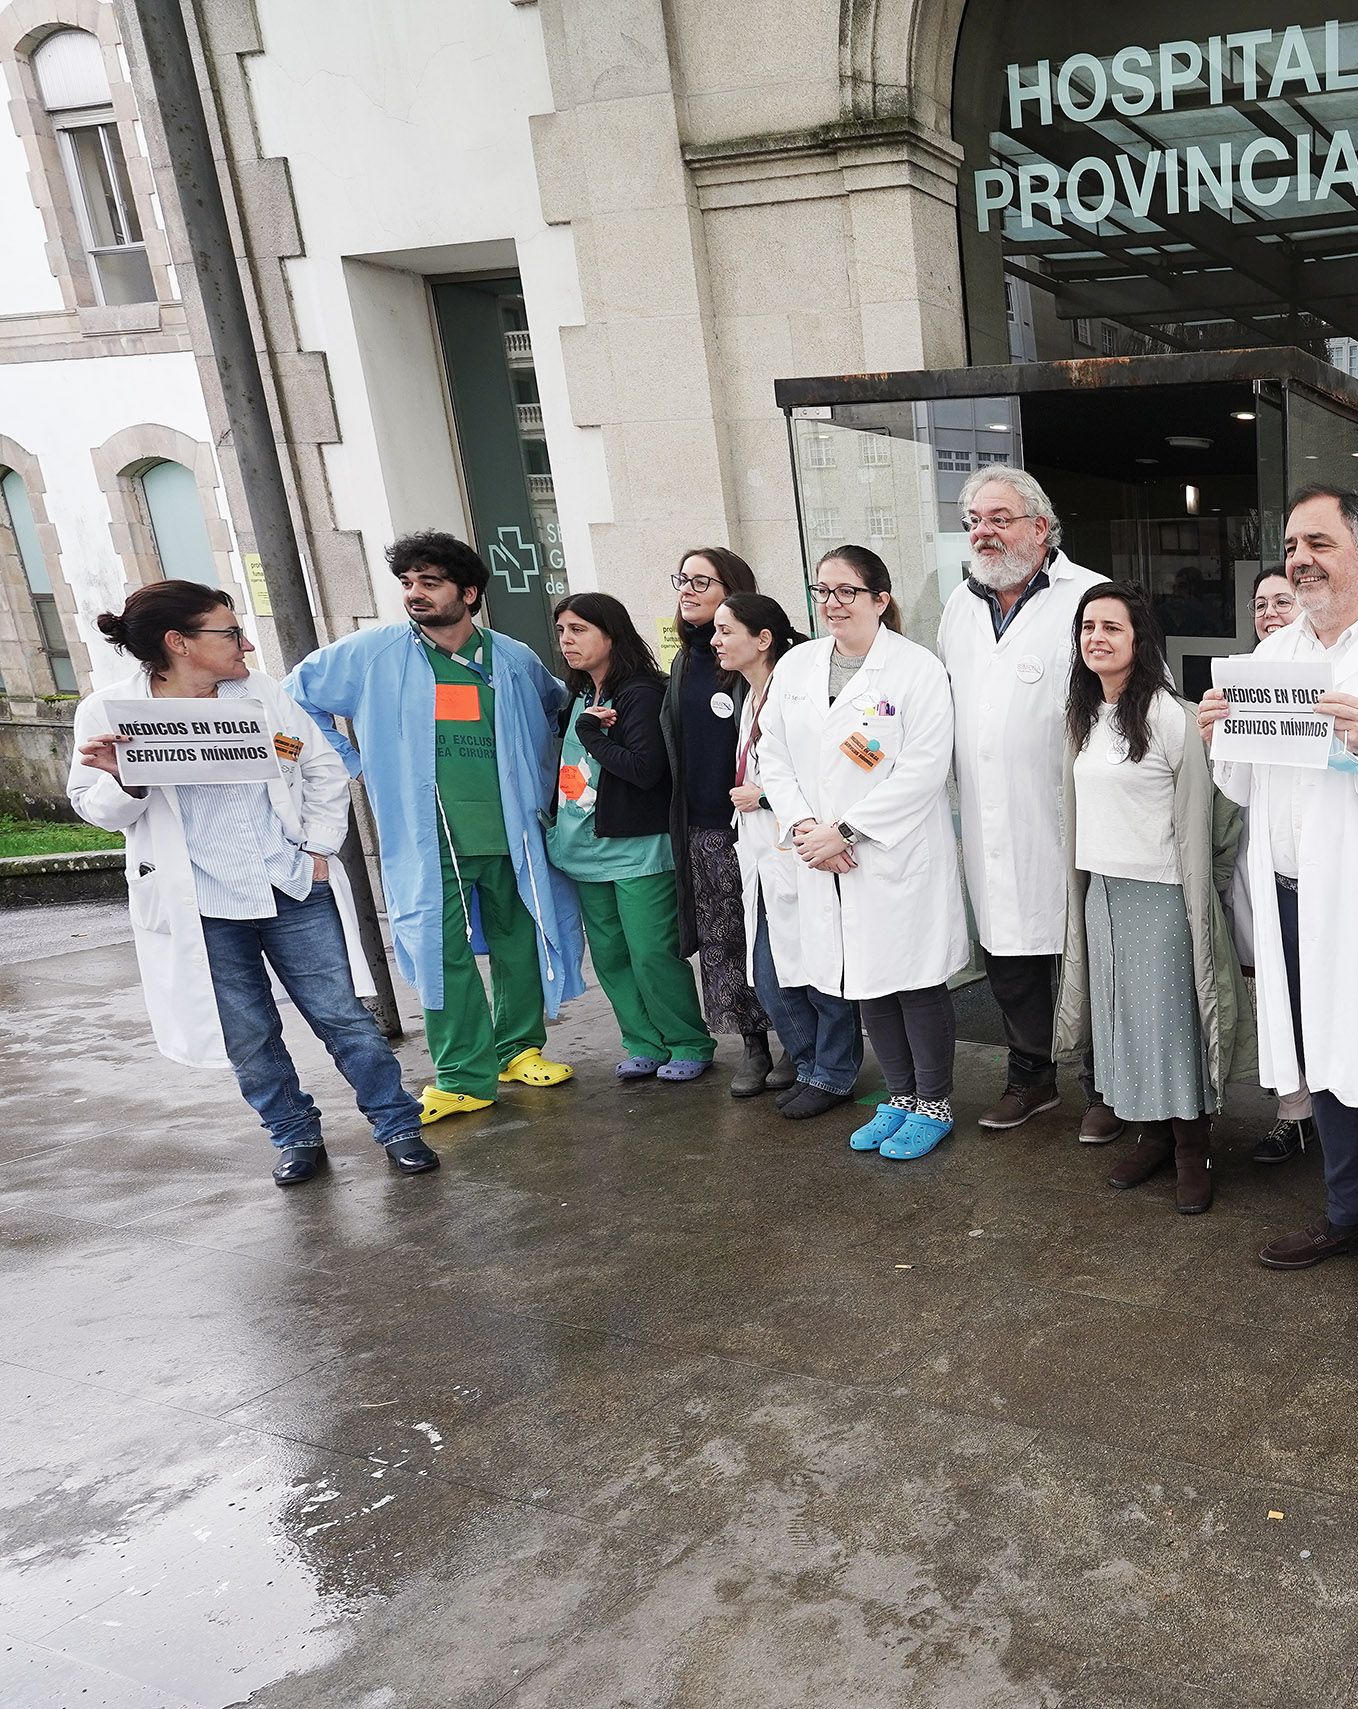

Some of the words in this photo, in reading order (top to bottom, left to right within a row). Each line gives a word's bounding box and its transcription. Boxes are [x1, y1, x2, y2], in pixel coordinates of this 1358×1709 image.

[550, 549, 564, 569] G
[545, 574, 565, 595] de
[1222, 685, 1272, 704] MÉDICOS
[1275, 688, 1289, 704] EN
[118, 721, 189, 736] MÉDICOS
[193, 721, 211, 735] EN
[215, 720, 261, 734] FOLGA
[1224, 719, 1277, 736] SERVIZOS
[1281, 718, 1329, 738] MÍNIMOS
[453, 735, 496, 747] EXCLUS
[126, 748, 197, 763] SERVIZOS
[200, 745, 269, 761] MÍNIMOS
